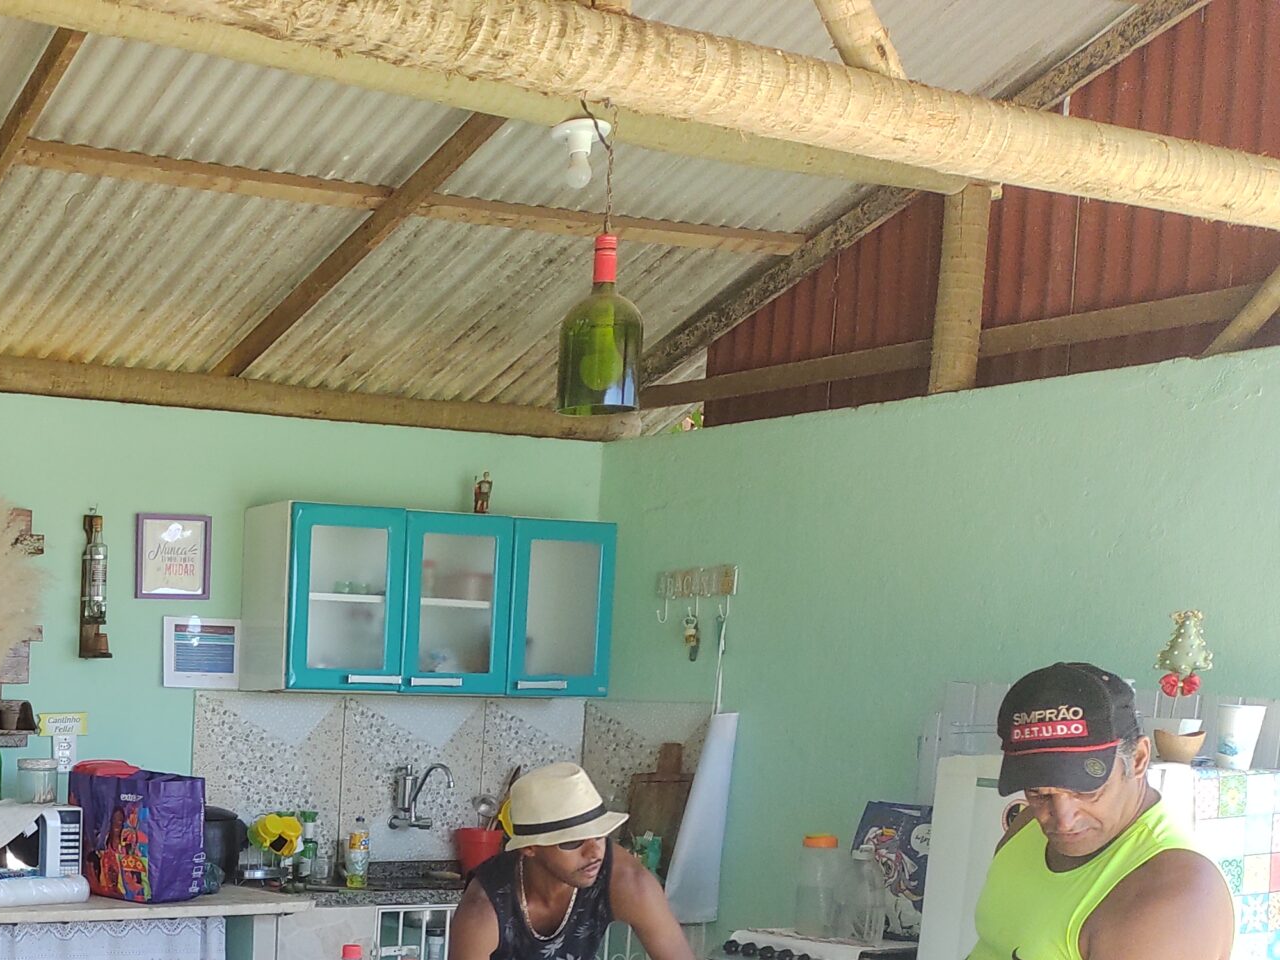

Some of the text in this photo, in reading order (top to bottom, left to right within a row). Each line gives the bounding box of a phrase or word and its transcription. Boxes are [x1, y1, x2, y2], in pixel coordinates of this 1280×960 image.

[164, 563, 195, 576] MUDAR
[47, 715, 81, 724] Cantinho
[1012, 704, 1084, 726] SIMPRÃO
[1013, 723, 1084, 740] D.E.T.U.D.O
